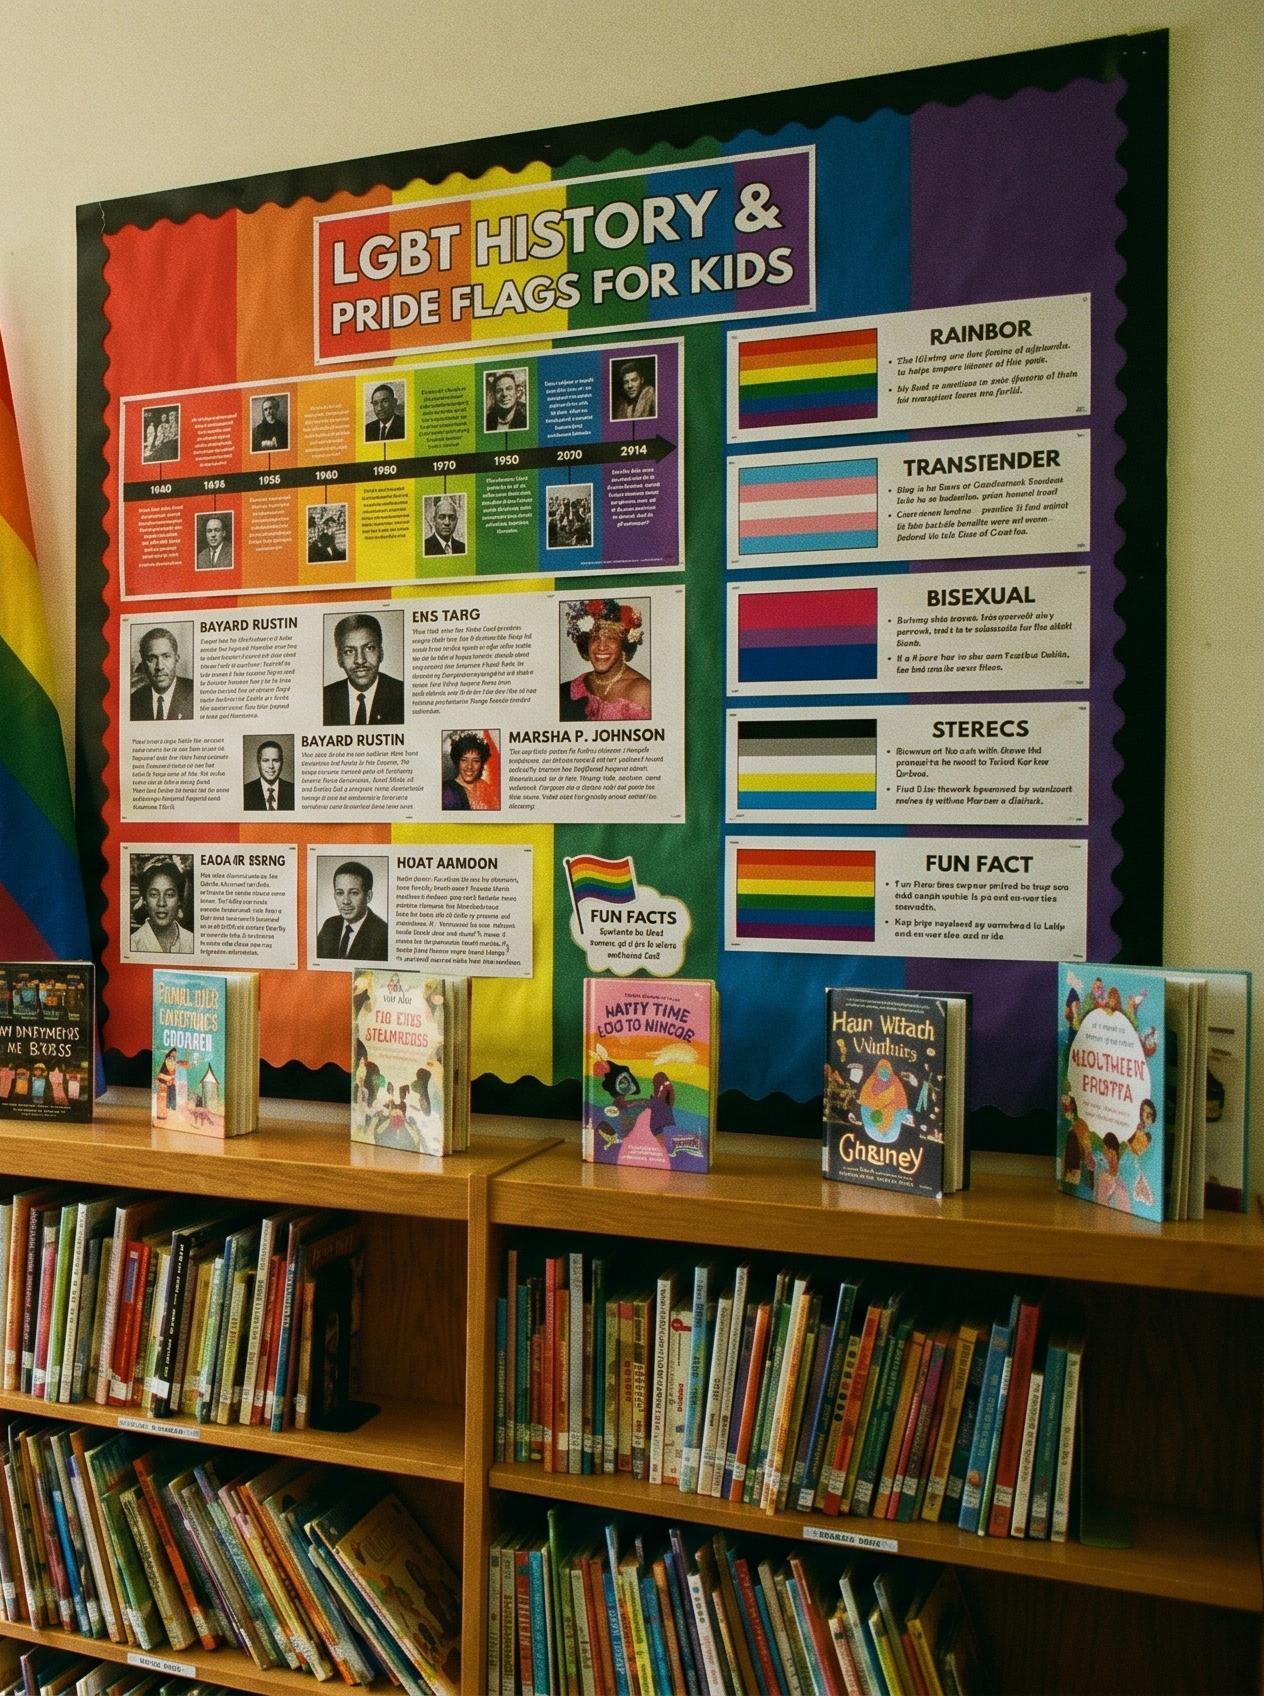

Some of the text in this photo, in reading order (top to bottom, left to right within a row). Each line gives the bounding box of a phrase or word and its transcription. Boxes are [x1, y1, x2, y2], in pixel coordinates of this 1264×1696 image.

[332, 182, 783, 285] LGBT HISTORY &
[332, 247, 793, 335] PRIDE FLAGS FOR KIDS
[931, 320, 1032, 345] RAINBOR
[433, 461, 456, 471] 1970
[494, 455, 519, 465] 1950
[927, 586, 1036, 607] BISEXUAL
[413, 609, 480, 623] ENS TARG
[200, 617, 297, 632] BAYARD RUSTIN
[509, 729, 665, 743] MARSHA P. JOHNSON
[932, 720, 1029, 738] STERECS
[301, 733, 404, 747] BAYARD RUSTIN
[397, 857, 498, 869] HOAT AAMOON
[926, 855, 1034, 873] FUN FACT
[591, 909, 677, 924] FUN FACTS
[653, 1003, 691, 1023] TIME
[626, 1019, 641, 1032] TO
